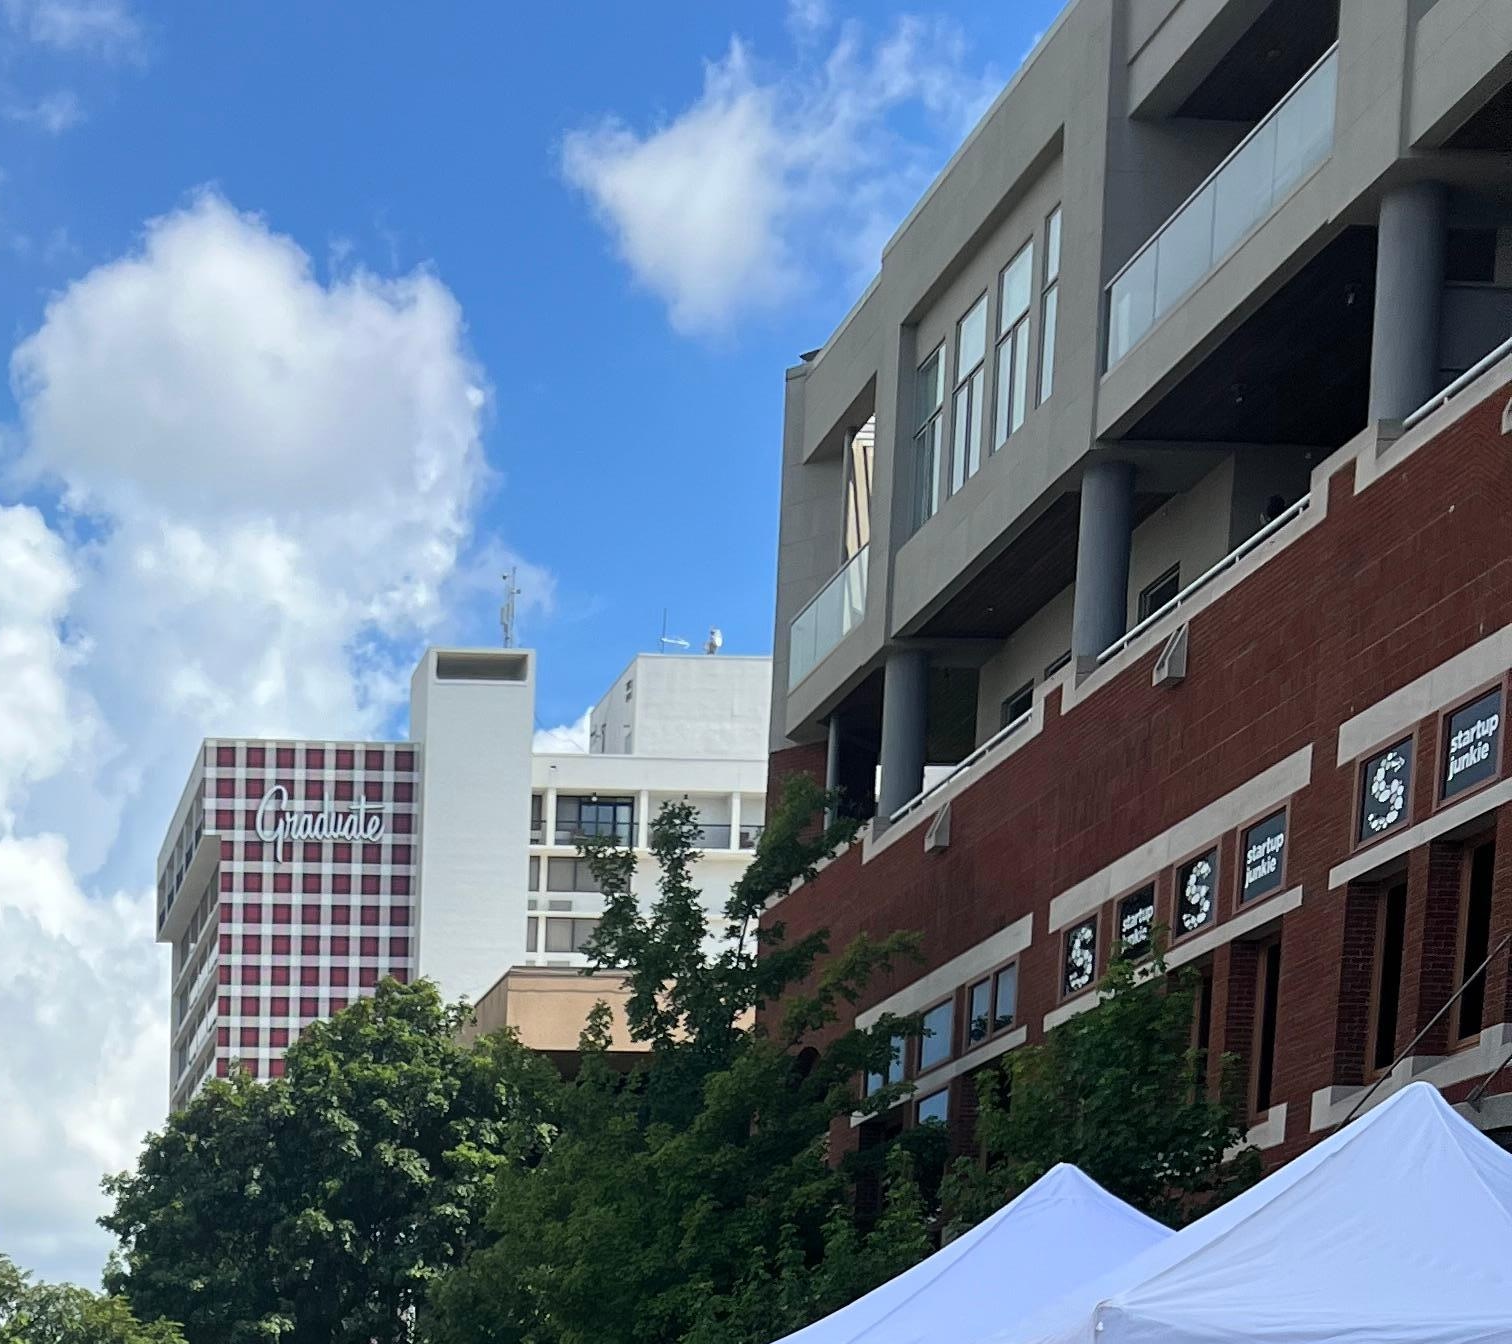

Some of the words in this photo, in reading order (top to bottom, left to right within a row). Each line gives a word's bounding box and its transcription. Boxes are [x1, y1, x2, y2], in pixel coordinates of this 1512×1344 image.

[1450, 714, 1499, 754] startup
[1447, 741, 1489, 781] junkie
[255, 785, 385, 863] Graduate
[1247, 833, 1285, 864] startup
[1245, 856, 1277, 888] junkie
